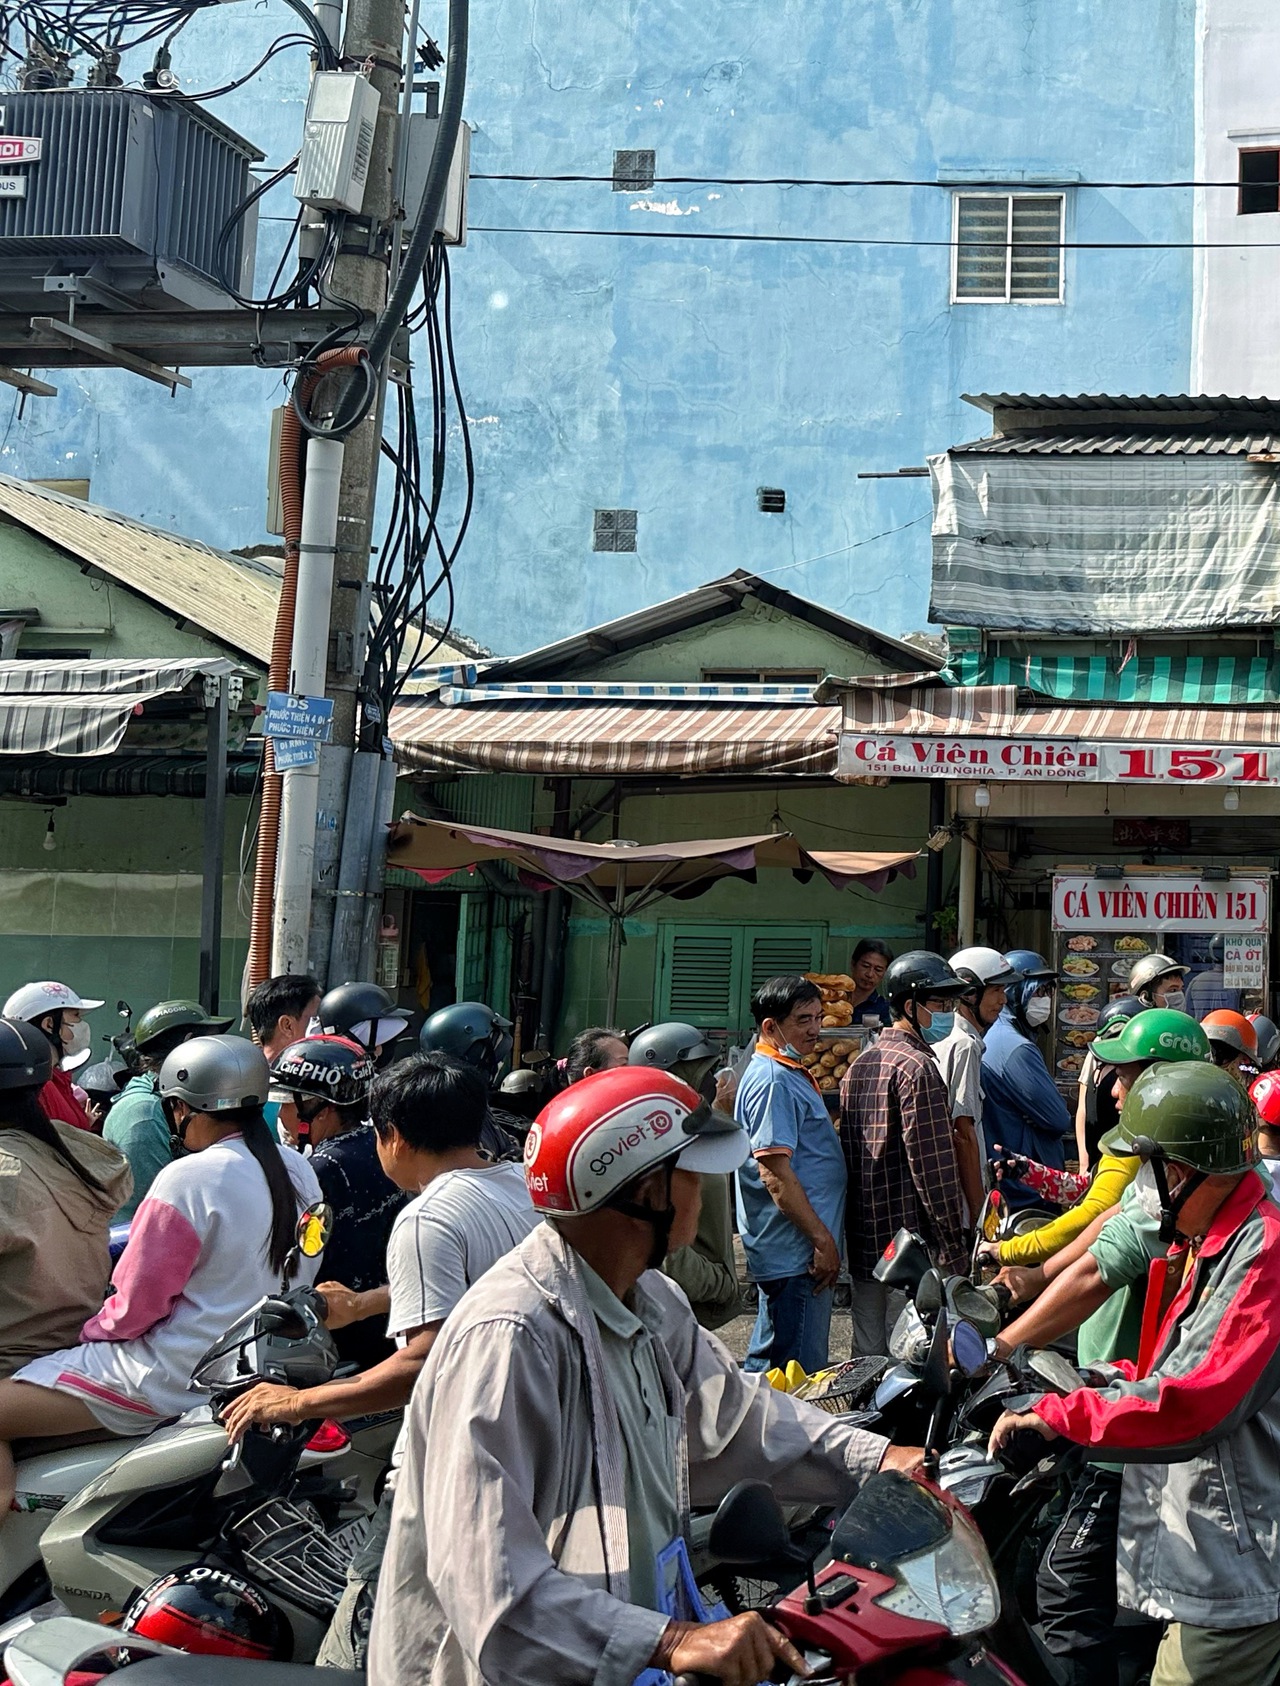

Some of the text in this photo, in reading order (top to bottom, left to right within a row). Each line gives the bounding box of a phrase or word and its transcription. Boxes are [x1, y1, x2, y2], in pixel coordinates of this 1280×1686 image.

[0, 143, 20, 157] DI
[0, 181, 16, 191] US
[287, 697, 309, 710] DS
[855, 739, 1272, 782] Cá Viên Chiên 151
[866, 763, 887, 772] 151
[1024, 768, 1043, 777] AN
[1063, 882, 1257, 920] CÁ VIÊN CHIÊN 151
[1245, 937, 1261, 947] QUA
[156, 1005, 187, 1018] PIAGGIO
[1159, 1031, 1202, 1056] Grab
[65, 1586, 114, 1602] HONDA
